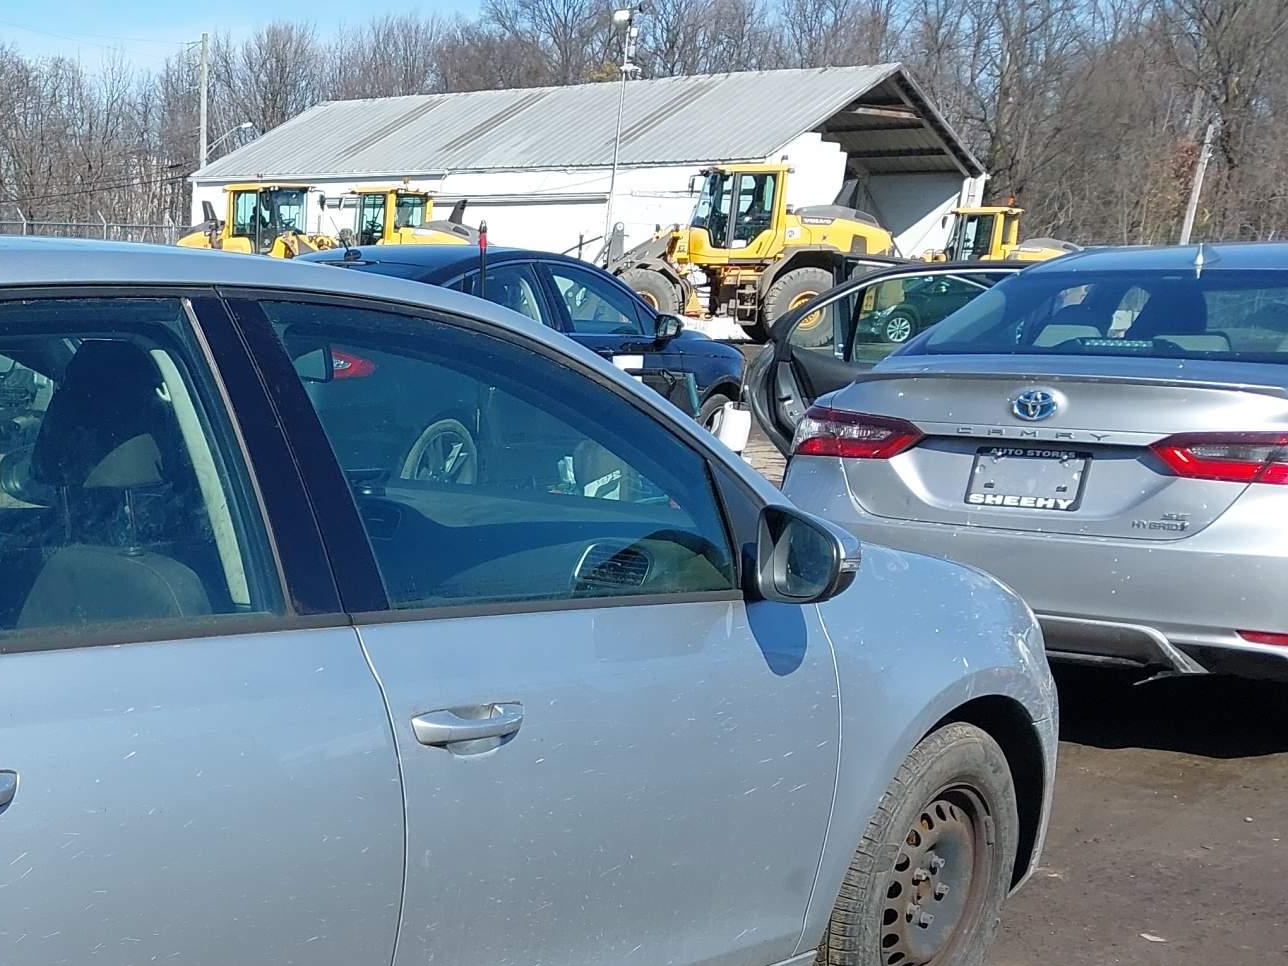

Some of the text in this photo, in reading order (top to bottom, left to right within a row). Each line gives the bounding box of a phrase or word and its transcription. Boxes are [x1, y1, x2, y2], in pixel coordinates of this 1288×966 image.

[956, 426, 1111, 441] CAMRY
[990, 447, 1076, 459] AUTO STORES
[968, 493, 1075, 510] SHEEHY
[1131, 520, 1179, 531] HYBRID
